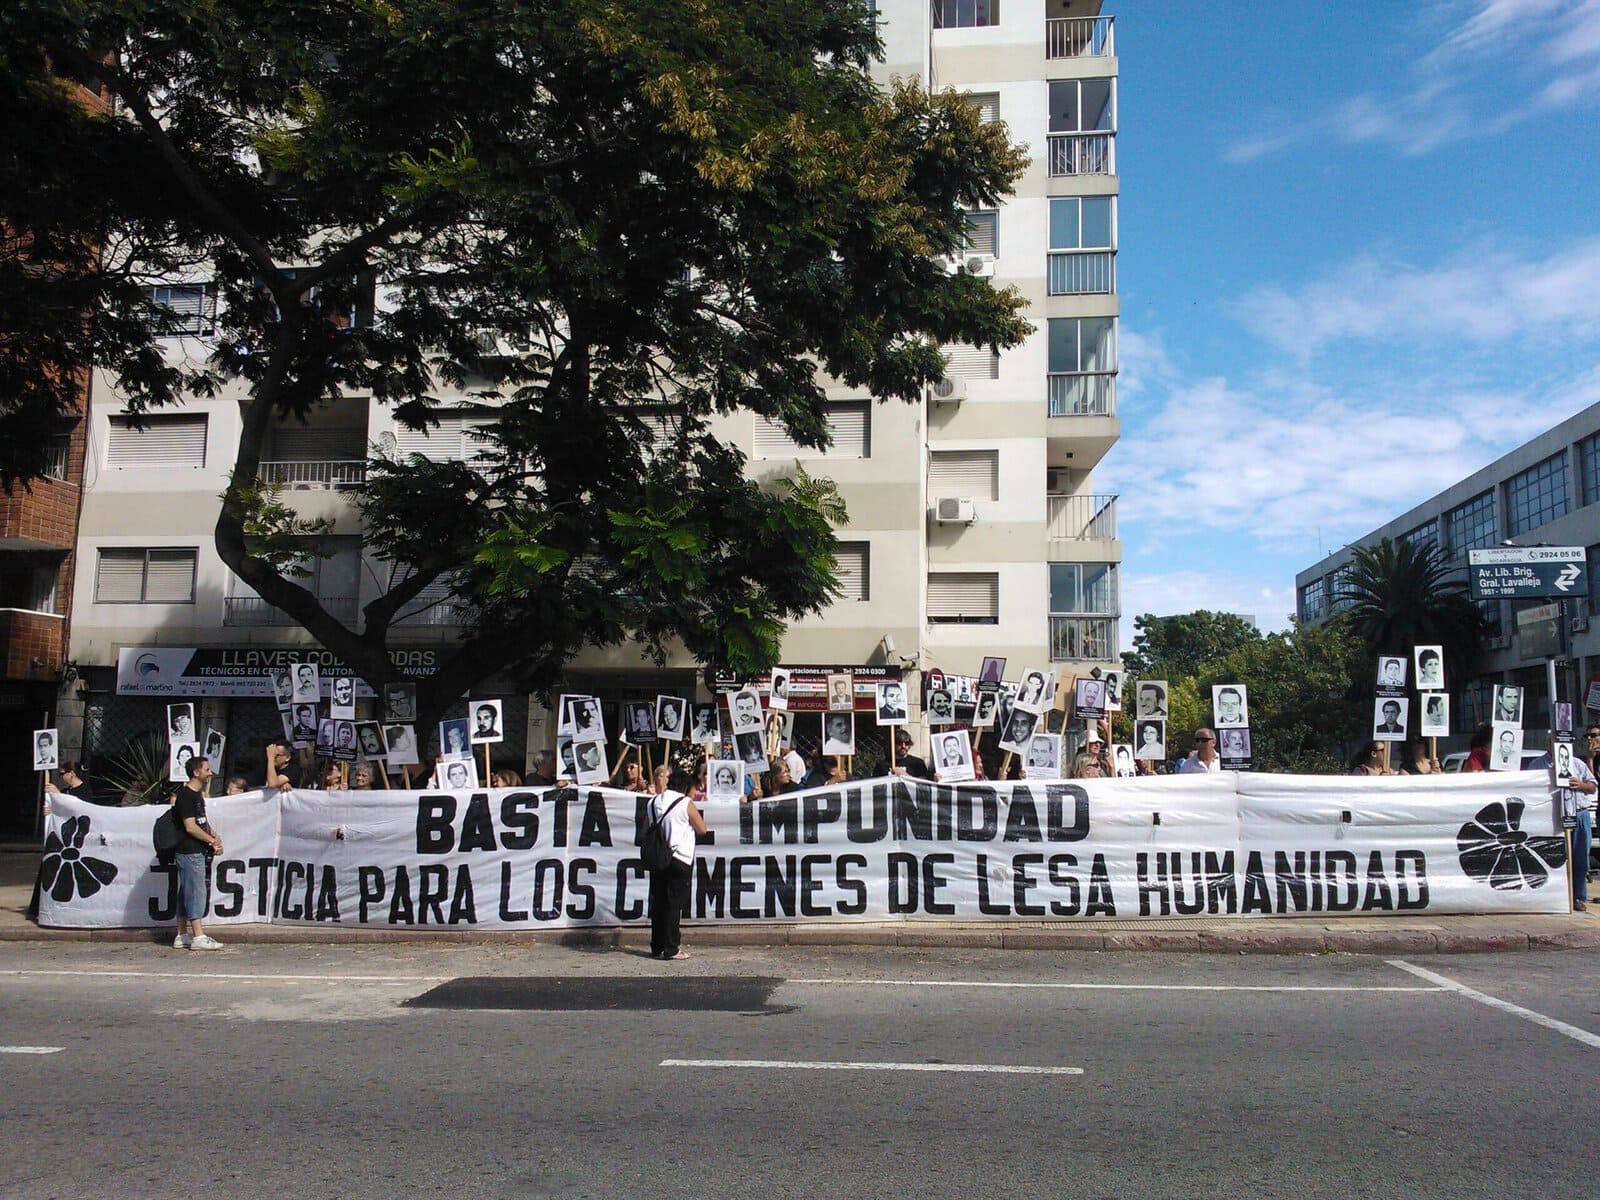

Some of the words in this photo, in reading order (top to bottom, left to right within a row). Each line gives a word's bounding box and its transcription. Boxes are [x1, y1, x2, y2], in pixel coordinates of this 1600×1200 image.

[1479, 568, 1493, 577] Av.
[1495, 568, 1511, 577] Lib.
[1513, 567, 1535, 578] Brig.
[1480, 579, 1500, 588] Gral.
[1502, 577, 1541, 588] Lavalleja
[222, 651, 300, 666] LLAVES
[200, 666, 246, 676] TÉCNICOS
[247, 667, 262, 675] EN
[871, 667, 887, 676] 0300
[146, 683, 173, 692] martino
[416, 788, 613, 854] BASTA
[739, 782, 1090, 845] IMPUNIDAD
[149, 857, 341, 923] JSTICIA
[359, 863, 477, 924] PARA
[499, 857, 597, 922] LOS
[888, 852, 955, 915] DE
[977, 853, 1116, 917] LESA
[1136, 849, 1430, 916] HUMANIDAD
